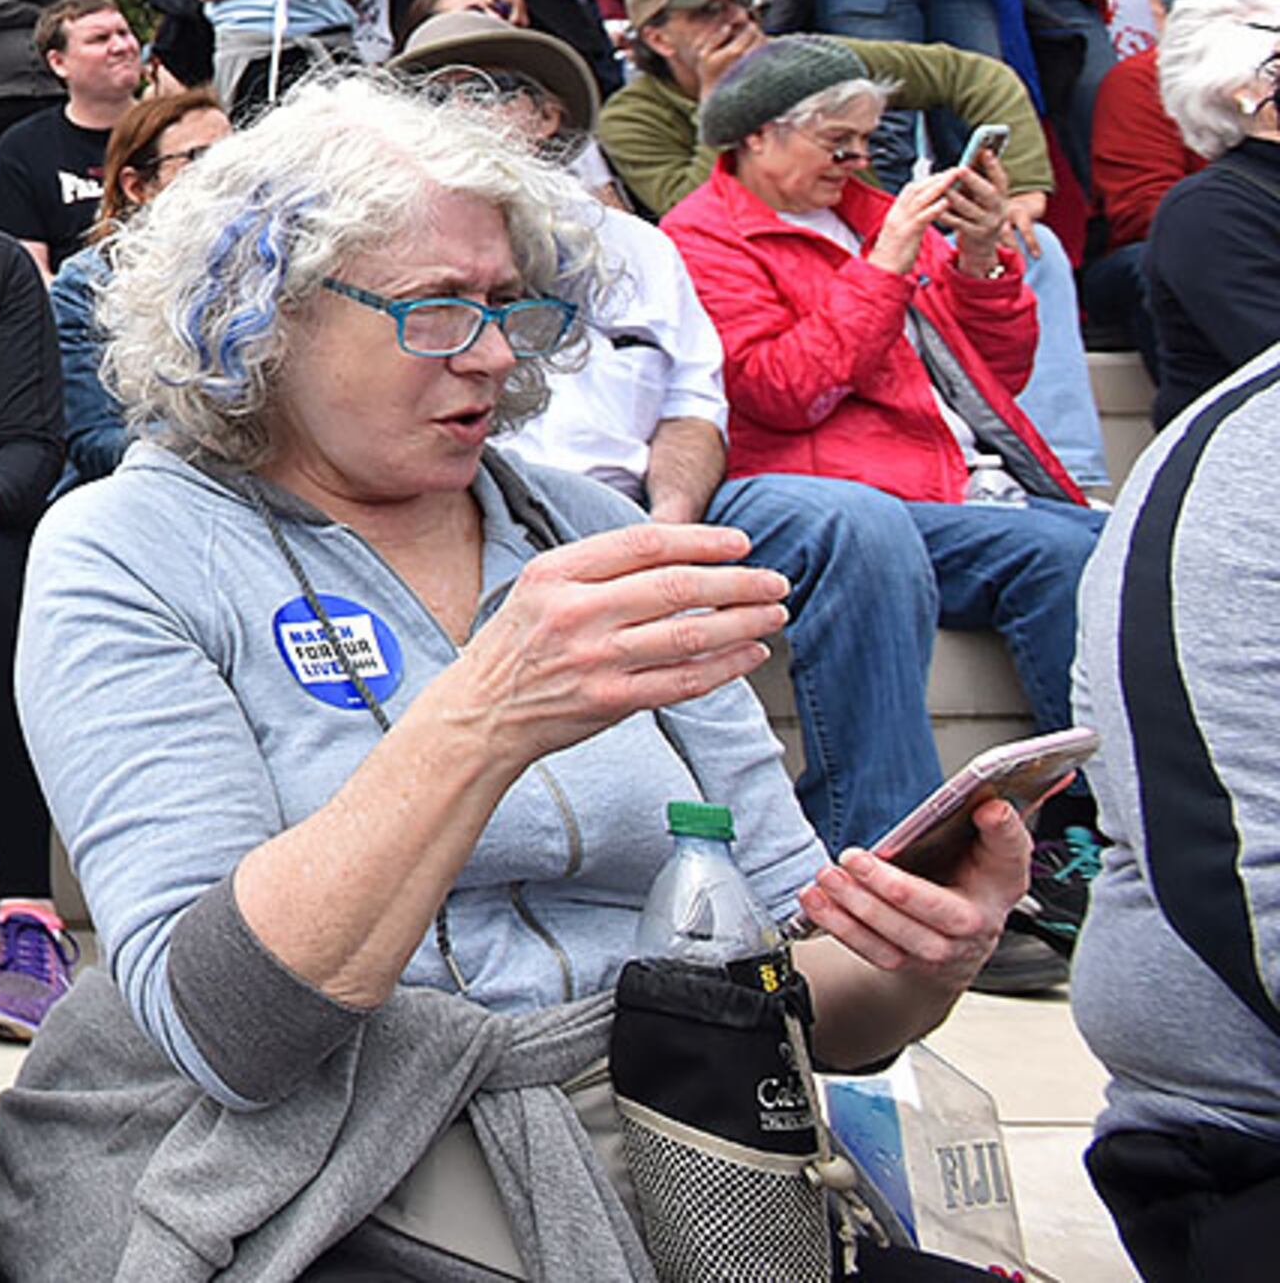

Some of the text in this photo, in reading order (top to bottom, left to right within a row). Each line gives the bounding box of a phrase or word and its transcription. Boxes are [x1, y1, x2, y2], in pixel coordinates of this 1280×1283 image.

[289, 626, 354, 644] MARH
[301, 661, 347, 677] LIVE
[937, 1141, 1008, 1209] FIJI
